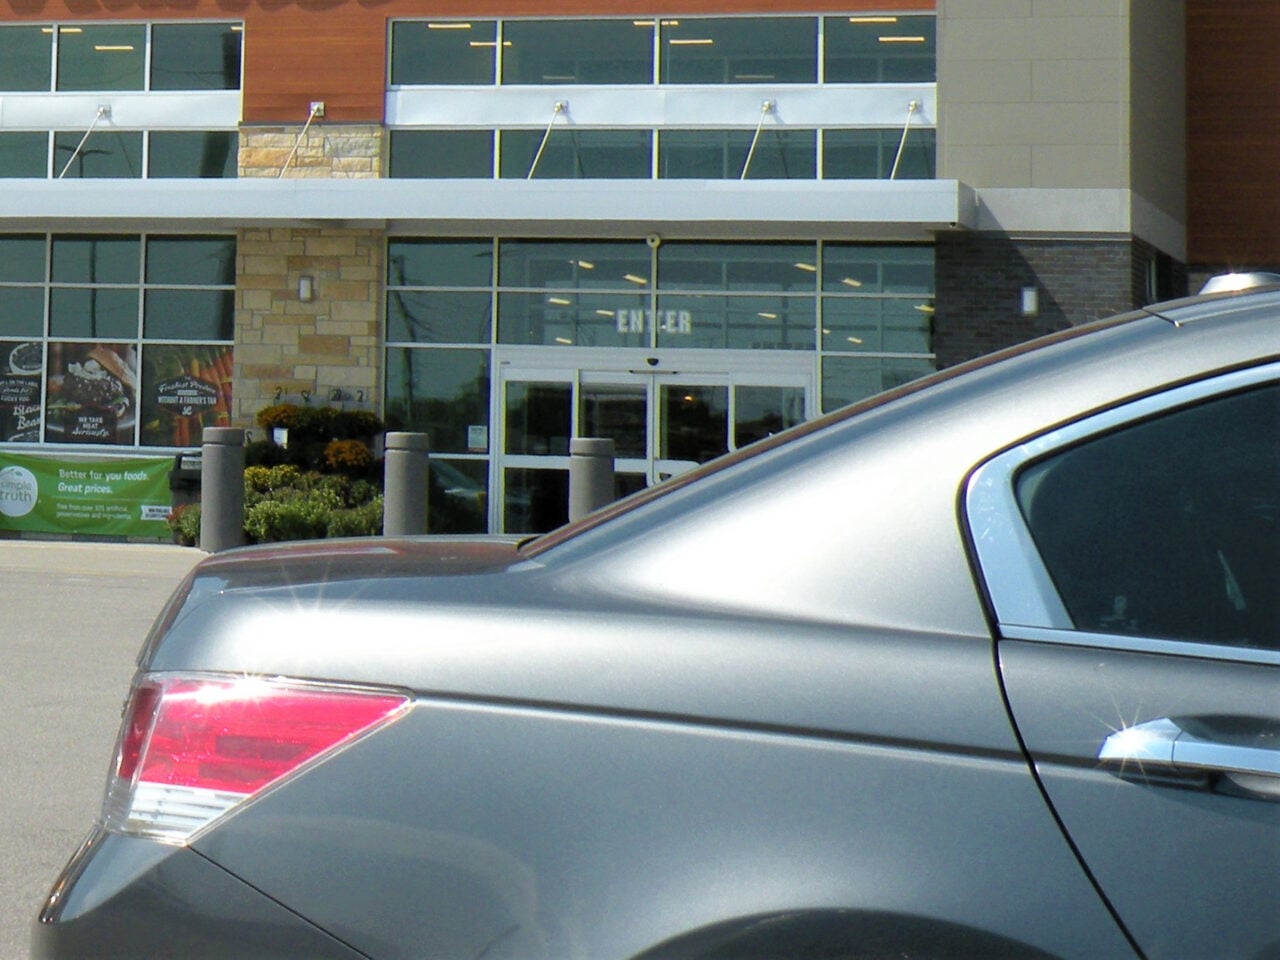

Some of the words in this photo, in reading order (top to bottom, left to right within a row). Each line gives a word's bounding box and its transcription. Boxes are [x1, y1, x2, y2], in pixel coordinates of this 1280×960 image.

[13, 404, 41, 416] Blac
[58, 468, 87, 480] Better
[89, 470, 103, 480] for
[105, 472, 122, 482] you
[123, 470, 150, 481] foods.
[0, 480, 32, 491] simple
[57, 481, 83, 493] Great
[84, 483, 113, 495] prices.
[0, 490, 32, 502] truth
